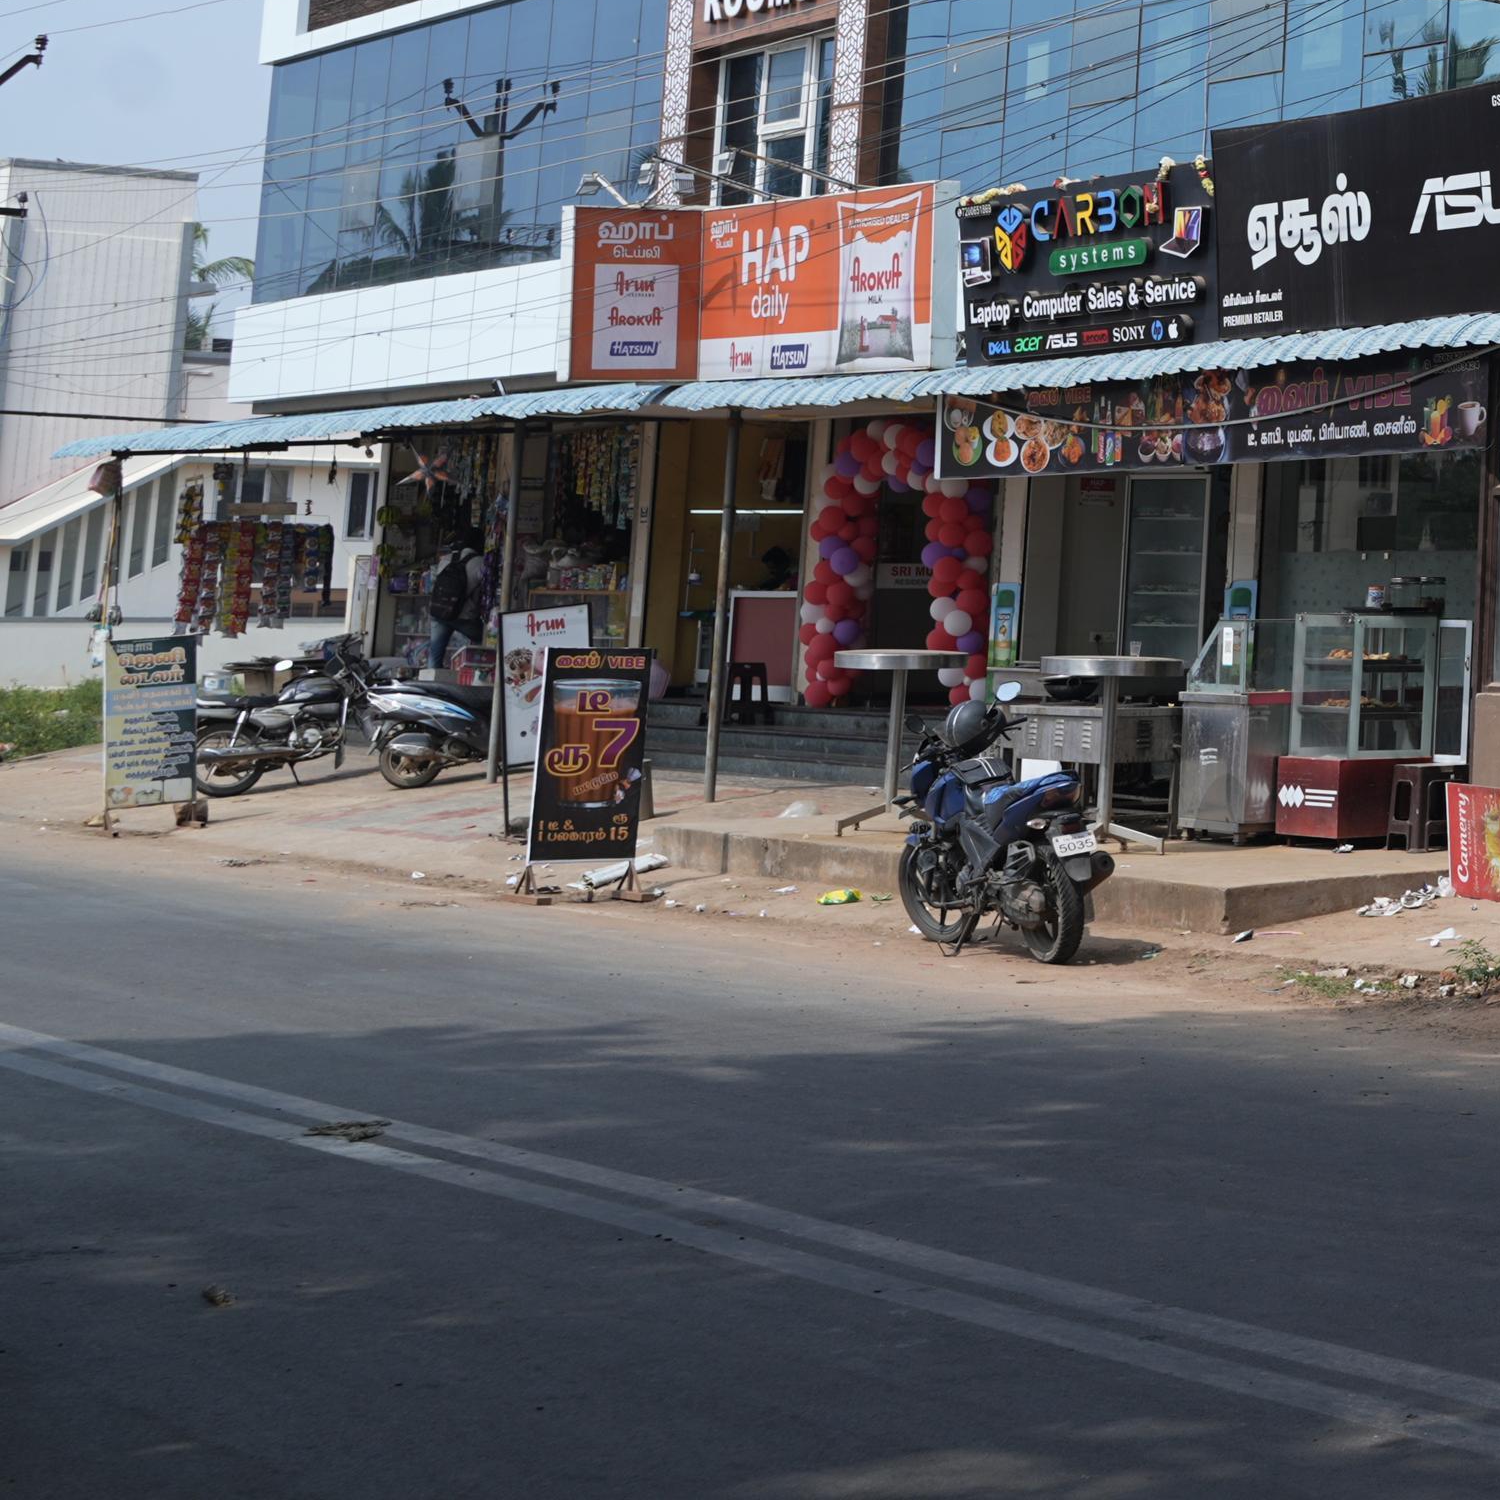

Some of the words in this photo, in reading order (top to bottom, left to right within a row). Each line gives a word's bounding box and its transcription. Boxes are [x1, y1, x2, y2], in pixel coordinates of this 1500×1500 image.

[597, 214, 674, 248] ஹாப்
[1247, 173, 1371, 270] ஏசூஸ்
[742, 225, 810, 285] HAP
[1059, 245, 1137, 271] systems
[616, 271, 656, 296] Arun
[850, 253, 902, 292] AROKYA
[608, 306, 663, 326] AROKYA
[752, 286, 789, 324] daily
[970, 302, 1010, 328] Laptop
[1023, 293, 1083, 320] Computer
[1088, 287, 1123, 310] Sales
[1128, 283, 1139, 305] &
[1145, 277, 1196, 303] Service
[1223, 313, 1252, 327] PREMIUM
[1254, 310, 1283, 323] RETAILER
[611, 341, 657, 356] HATSUN
[988, 342, 1011, 355] DELL
[1014, 336, 1043, 352] acer
[1045, 333, 1077, 349] ASUS
[1113, 326, 1145, 342] SONY
[730, 342, 752, 372] Arun
[771, 345, 808, 368] HATSUN
[1344, 372, 1412, 411] VIBE
[525, 613, 565, 637] Arun
[607, 656, 646, 669] VIBE
[593, 718, 640, 768] 7
[610, 827, 629, 841] 15
[1059, 839, 1094, 853] 5035
[1457, 792, 1470, 883] Camerry
